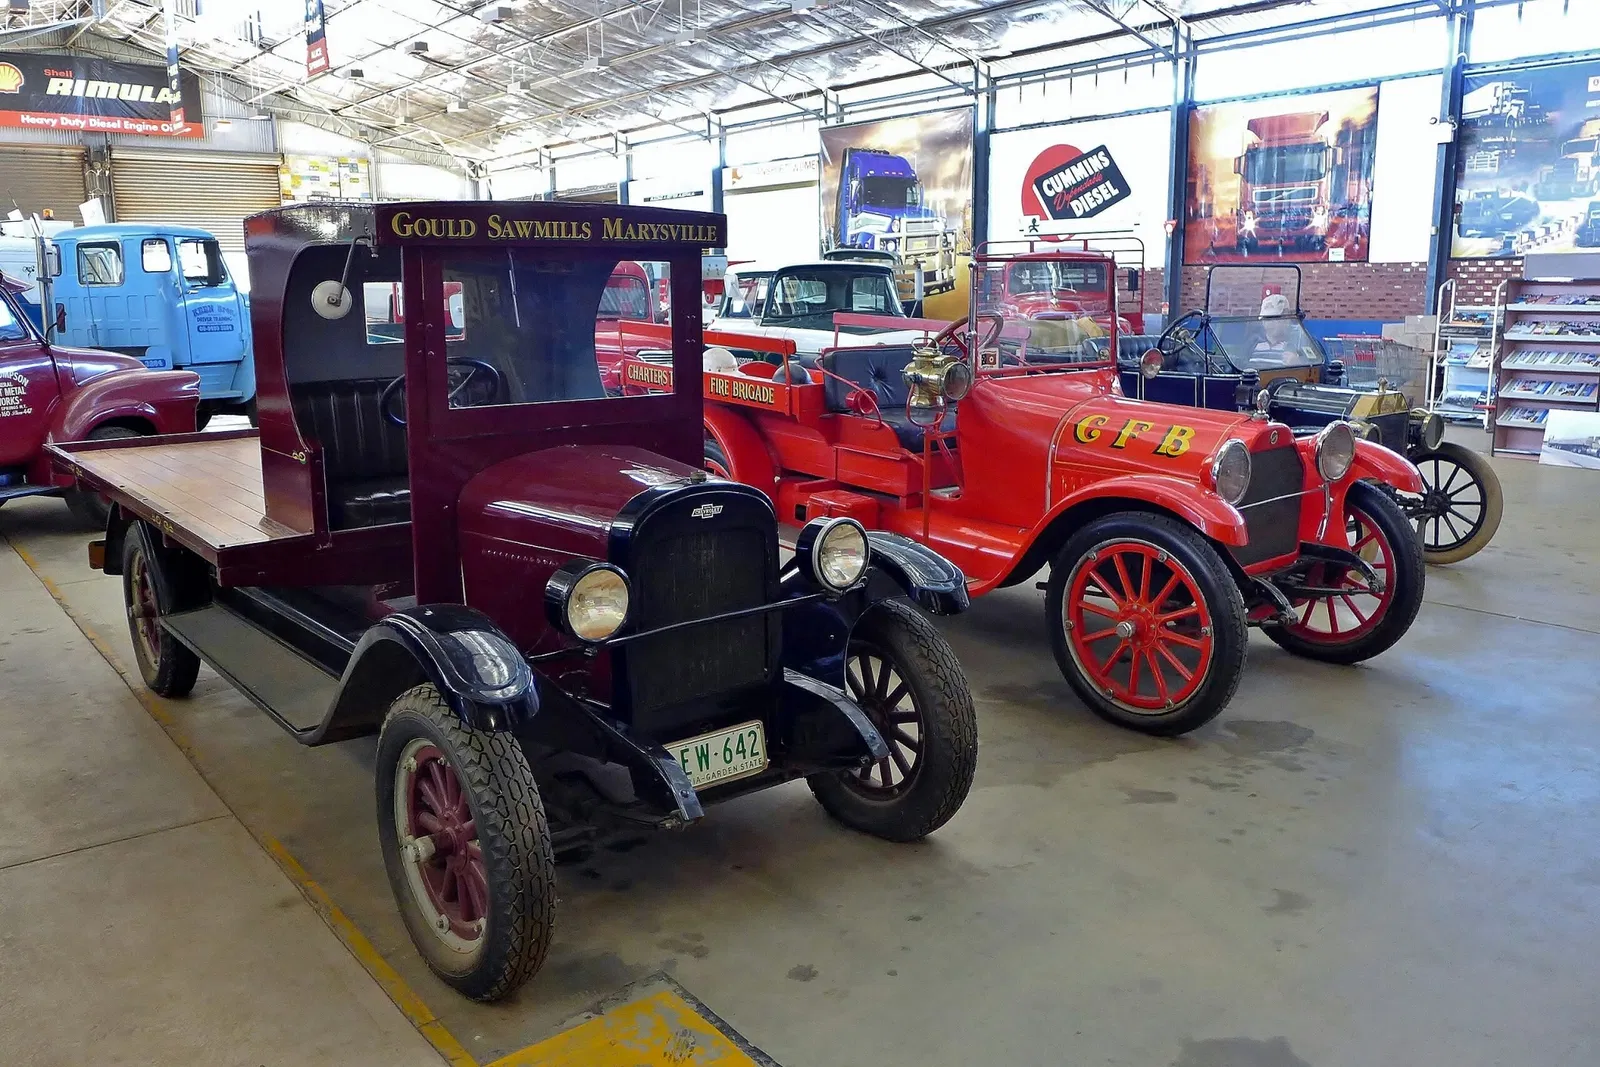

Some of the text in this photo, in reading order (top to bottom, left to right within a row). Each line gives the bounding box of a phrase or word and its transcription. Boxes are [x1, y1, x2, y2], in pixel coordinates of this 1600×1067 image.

[44, 69, 73, 77] Shell
[46, 78, 170, 103] RIMULA
[21, 115, 57, 127] Heavy
[60, 117, 86, 129] Duty
[89, 118, 121, 129] Diesel
[124, 121, 159, 132] Engine
[161, 123, 173, 132] Oi
[1042, 151, 1110, 197] CUMMINS
[1053, 171, 1104, 212] Dependable
[1070, 180, 1120, 217] DIESEL
[628, 364, 668, 386] CHARTERS
[4, 386, 26, 396] METAL
[710, 377, 775, 404] FIRE BRIGADE
[740, 757, 763, 771] STATE
